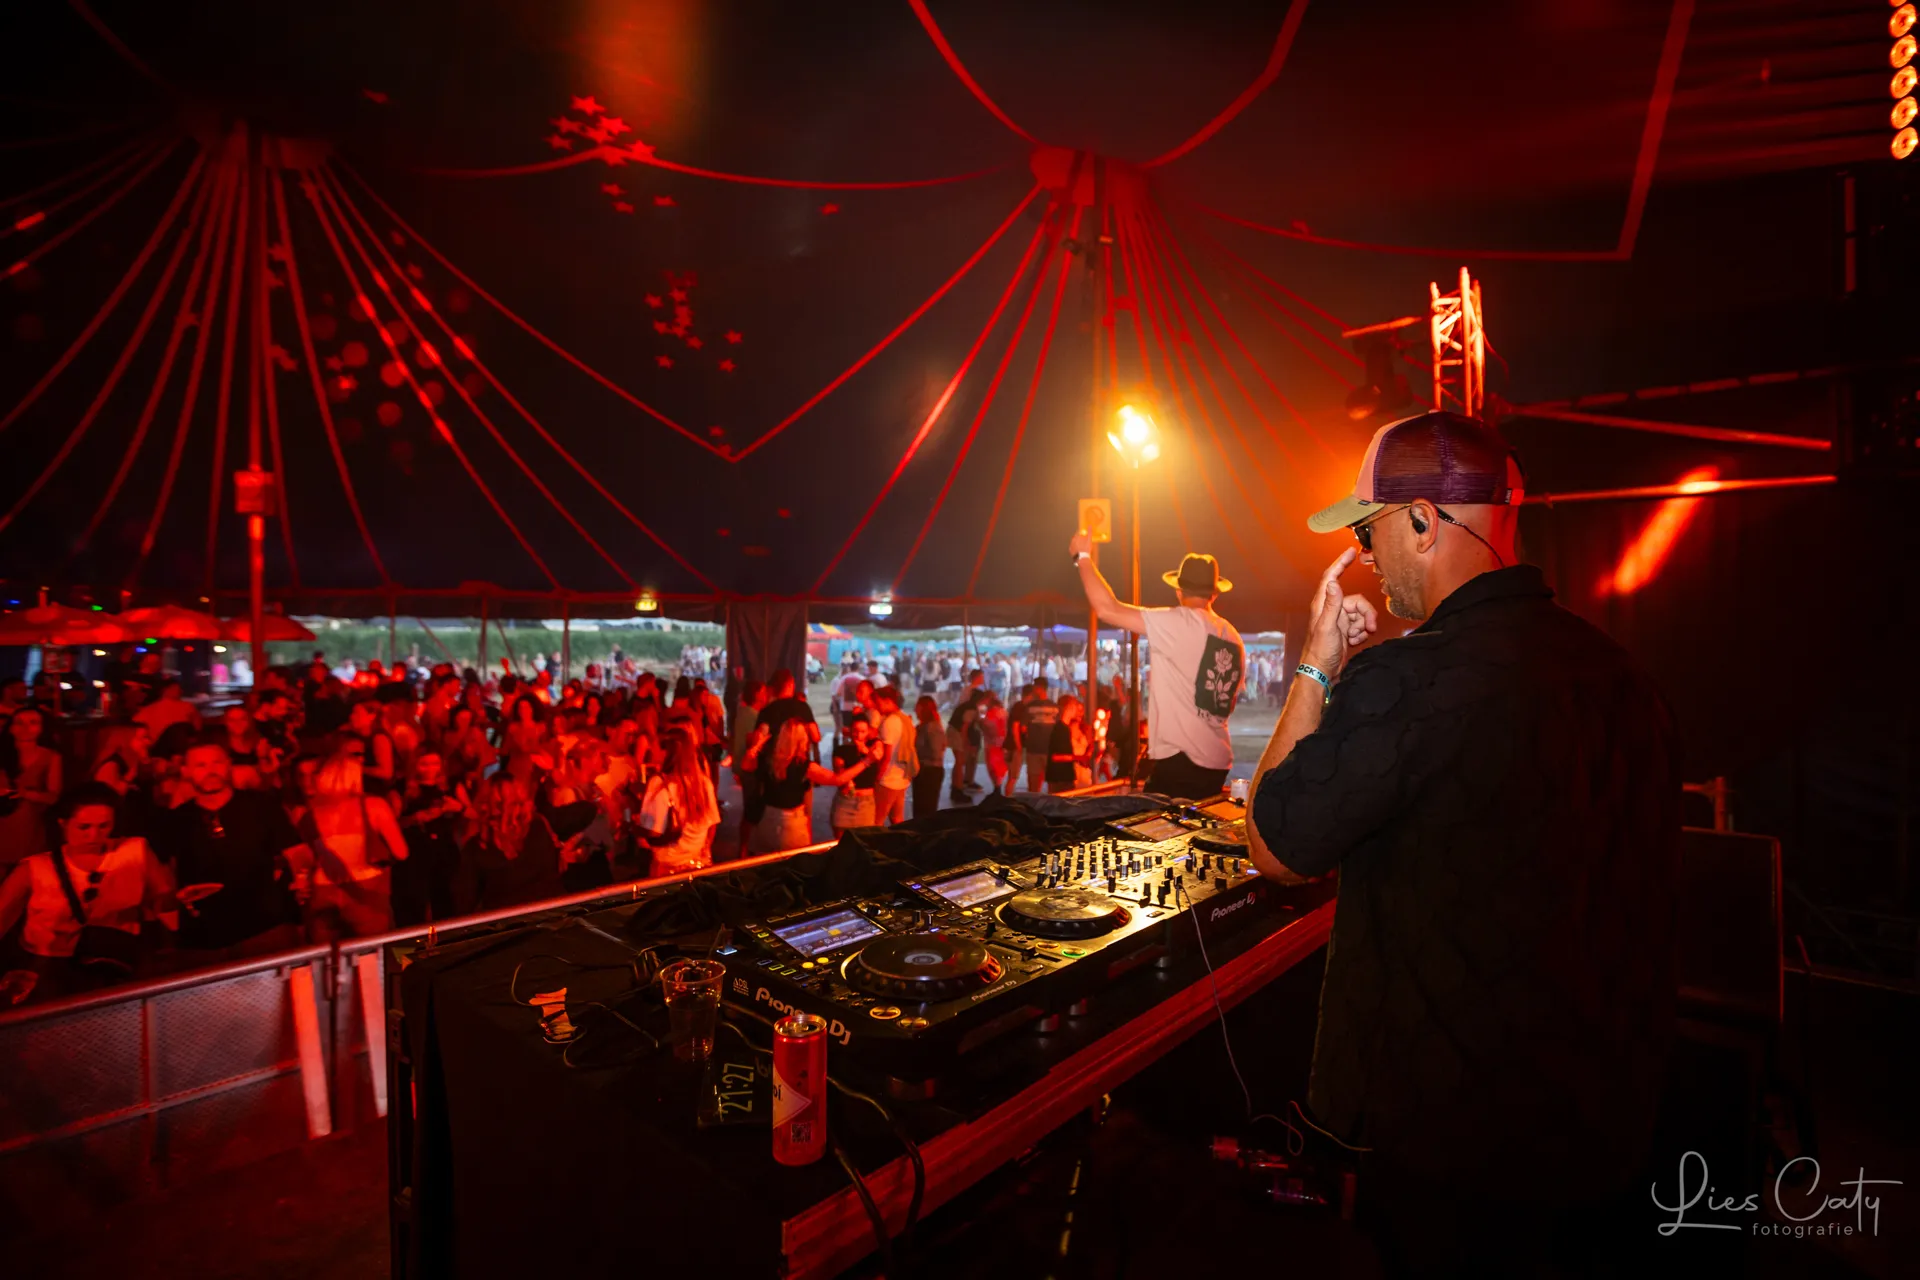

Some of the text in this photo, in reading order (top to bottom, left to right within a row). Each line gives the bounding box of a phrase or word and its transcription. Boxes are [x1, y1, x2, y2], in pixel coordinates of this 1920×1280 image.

[1210, 891, 1256, 922] Pioneer DJ
[755, 986, 806, 1016] Pione
[829, 1018, 851, 1046] DJ
[719, 1062, 755, 1115] 21:27
